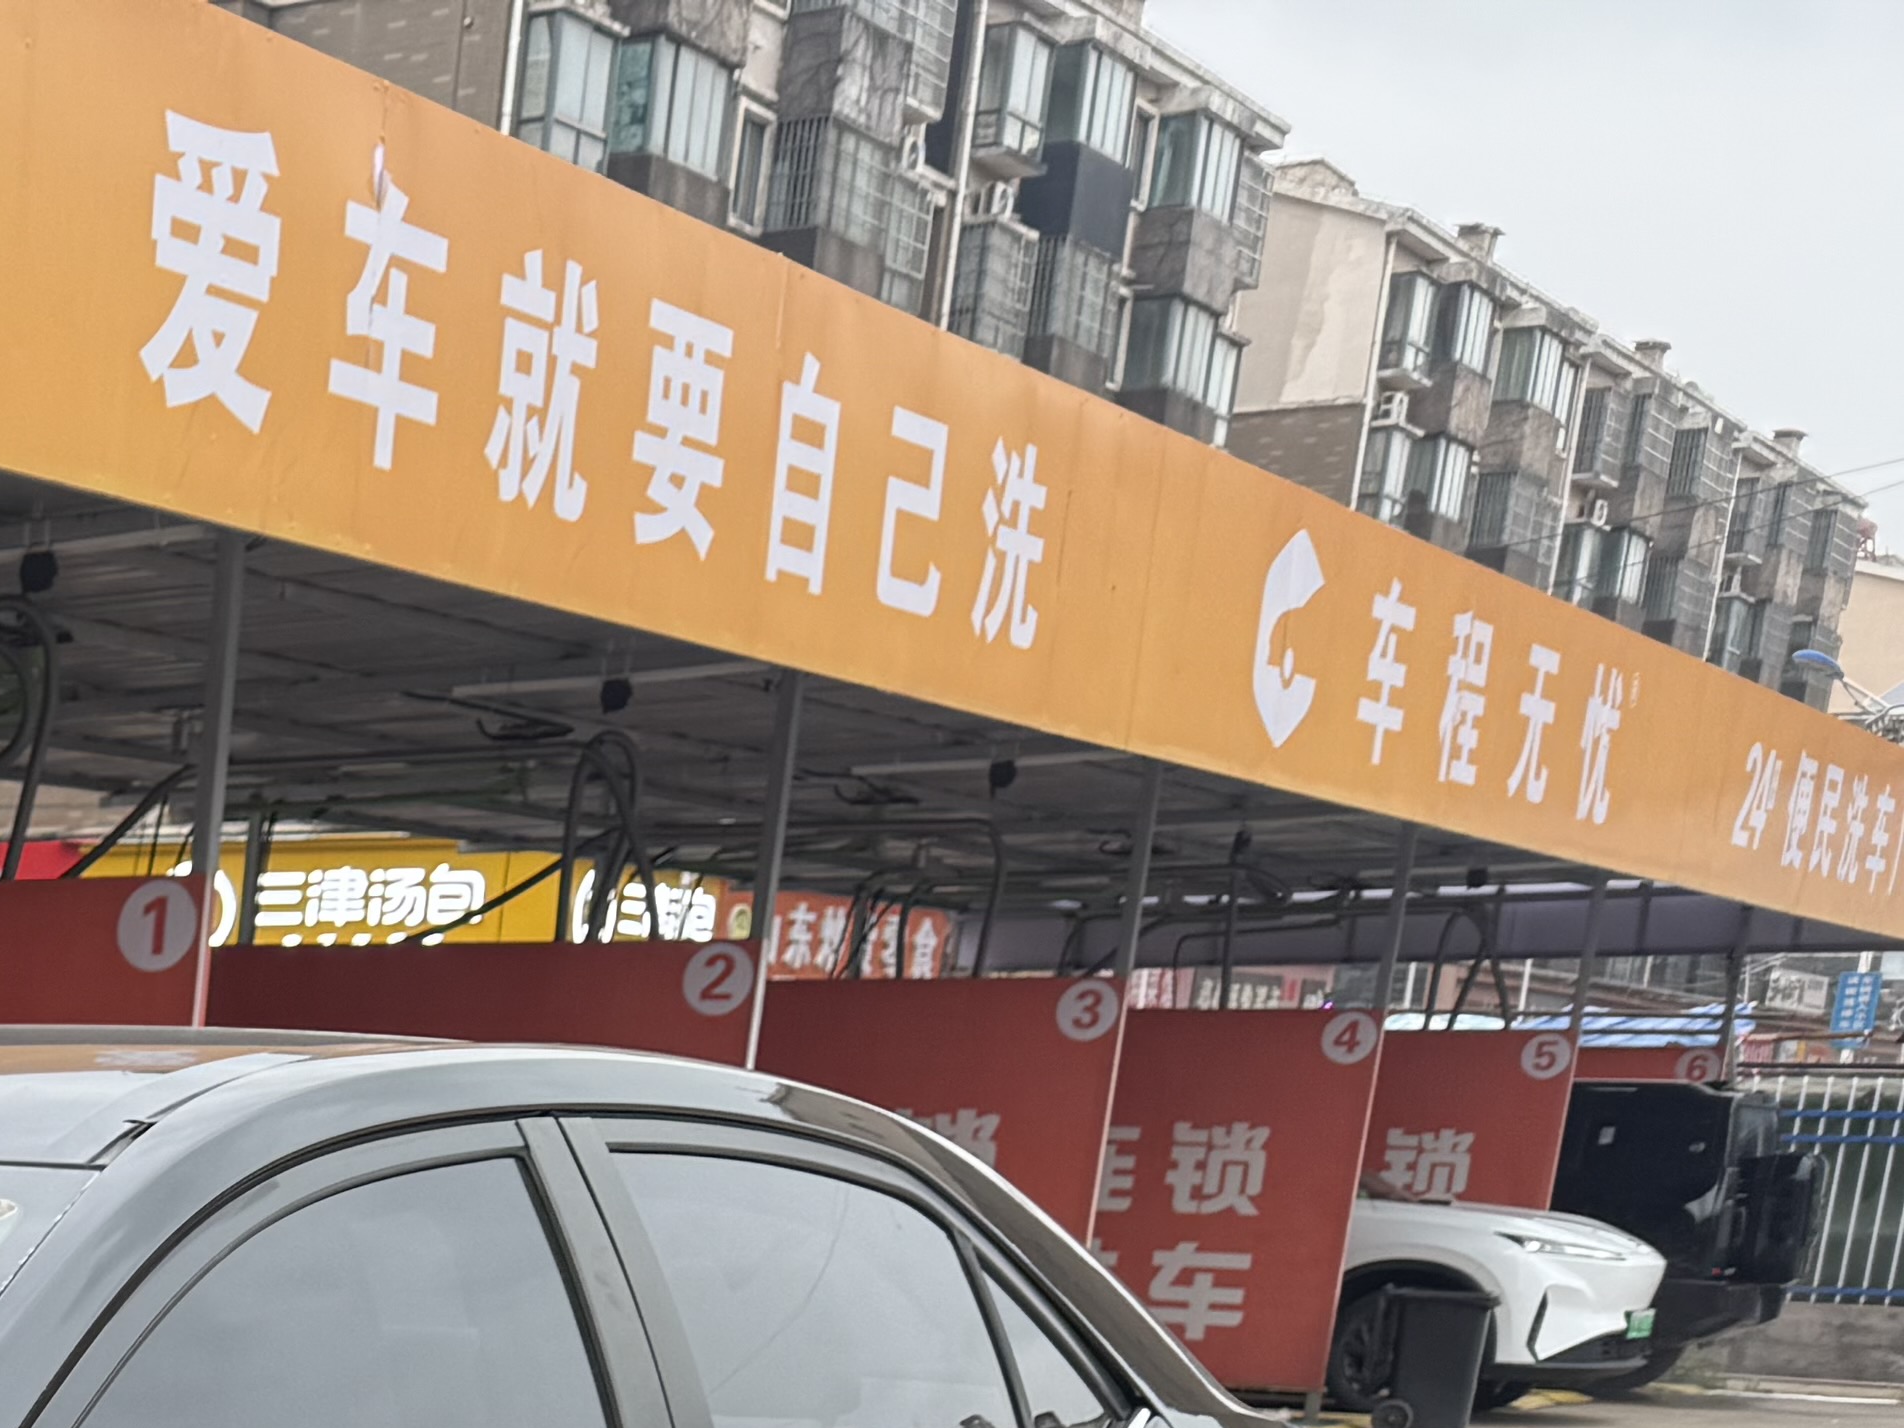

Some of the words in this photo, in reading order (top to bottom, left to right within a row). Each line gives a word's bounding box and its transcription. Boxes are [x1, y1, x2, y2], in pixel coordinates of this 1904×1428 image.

[139, 109, 1048, 650] 爱车就要自己洗
[1356, 577, 1624, 824] 车程无忧
[255, 863, 485, 927] 三津汤包
